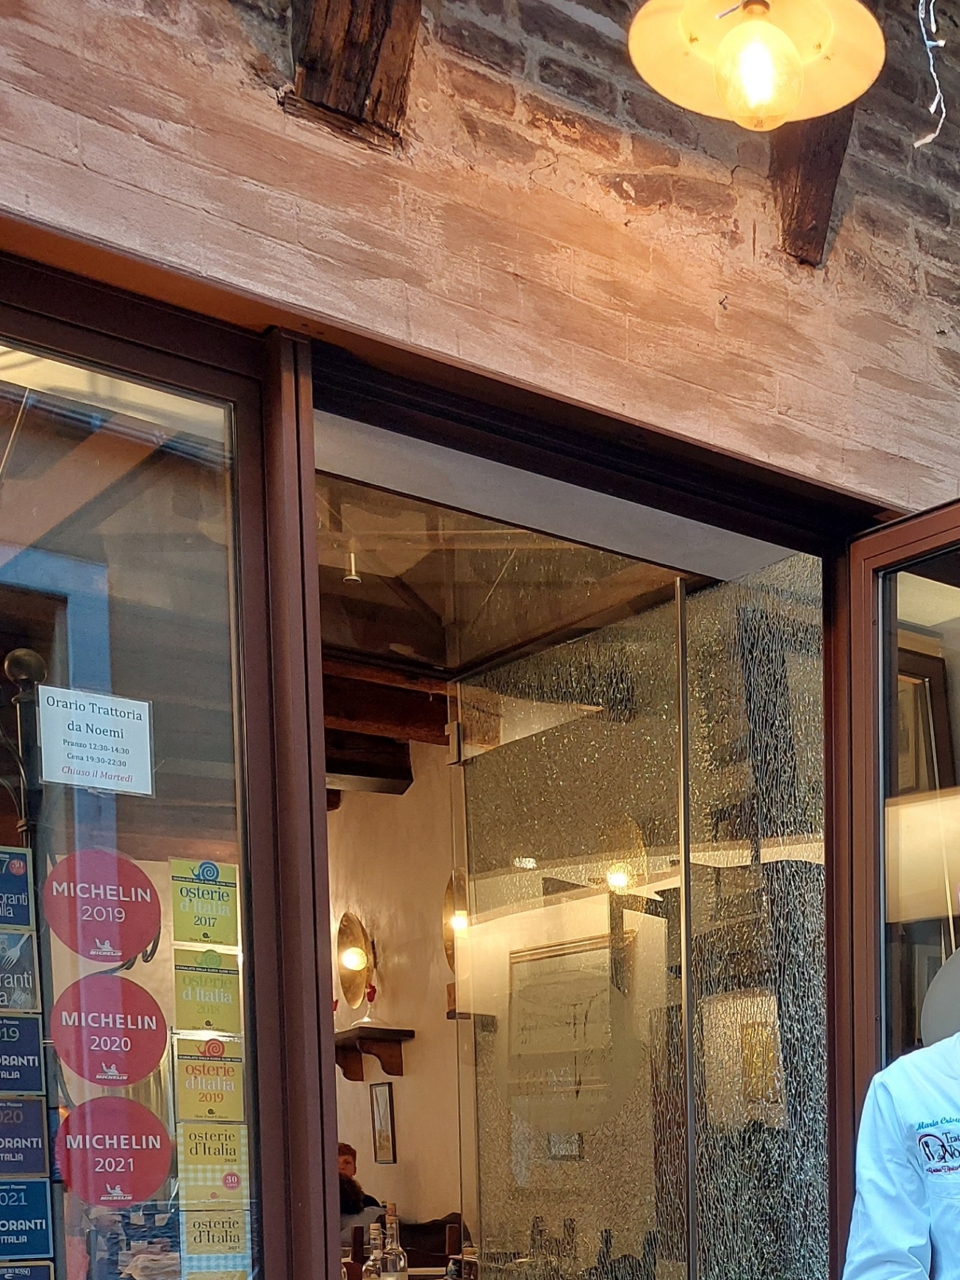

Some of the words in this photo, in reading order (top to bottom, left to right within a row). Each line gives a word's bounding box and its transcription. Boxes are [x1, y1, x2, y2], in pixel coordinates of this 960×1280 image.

[46, 695, 86, 712] Orario
[89, 702, 143, 721] Trattoria
[67, 720, 82, 733] da
[86, 723, 124, 739] Noemi
[62, 739, 87, 749] Pranzo
[89, 742, 130, 755] 12:30-14:30
[66, 752, 84, 761] Cena
[86, 755, 127, 767] 19:30-22:30
[61, 765, 91, 777] Chiuso
[92, 769, 98, 777] il
[52, 881, 151, 903] MICHELIN
[180, 886, 230, 902] osterie
[81, 905, 126, 923] 2019
[194, 915, 217, 928] 2017
[182, 975, 232, 988] osterie
[182, 986, 232, 1004] d'Italia
[197, 1005, 220, 1014] 2018
[61, 1011, 157, 1030] MICHELIN
[0, 1027, 20, 1041] 19
[90, 1036, 131, 1052] 2020
[0, 1055, 39, 1067] RANTI
[185, 1062, 235, 1078] osterie
[185, 1075, 235, 1092] d'Italia
[198, 1092, 224, 1103] 2019
[66, 1135, 161, 1149] MICHELIN
[188, 1129, 235, 1142] osterie
[189, 1142, 236, 1156] d'Italia
[94, 1158, 134, 1172] 2021
[225, 1175, 238, 1183] 30
[192, 1217, 239, 1230] osterie
[193, 1230, 240, 1244] d'Italia
